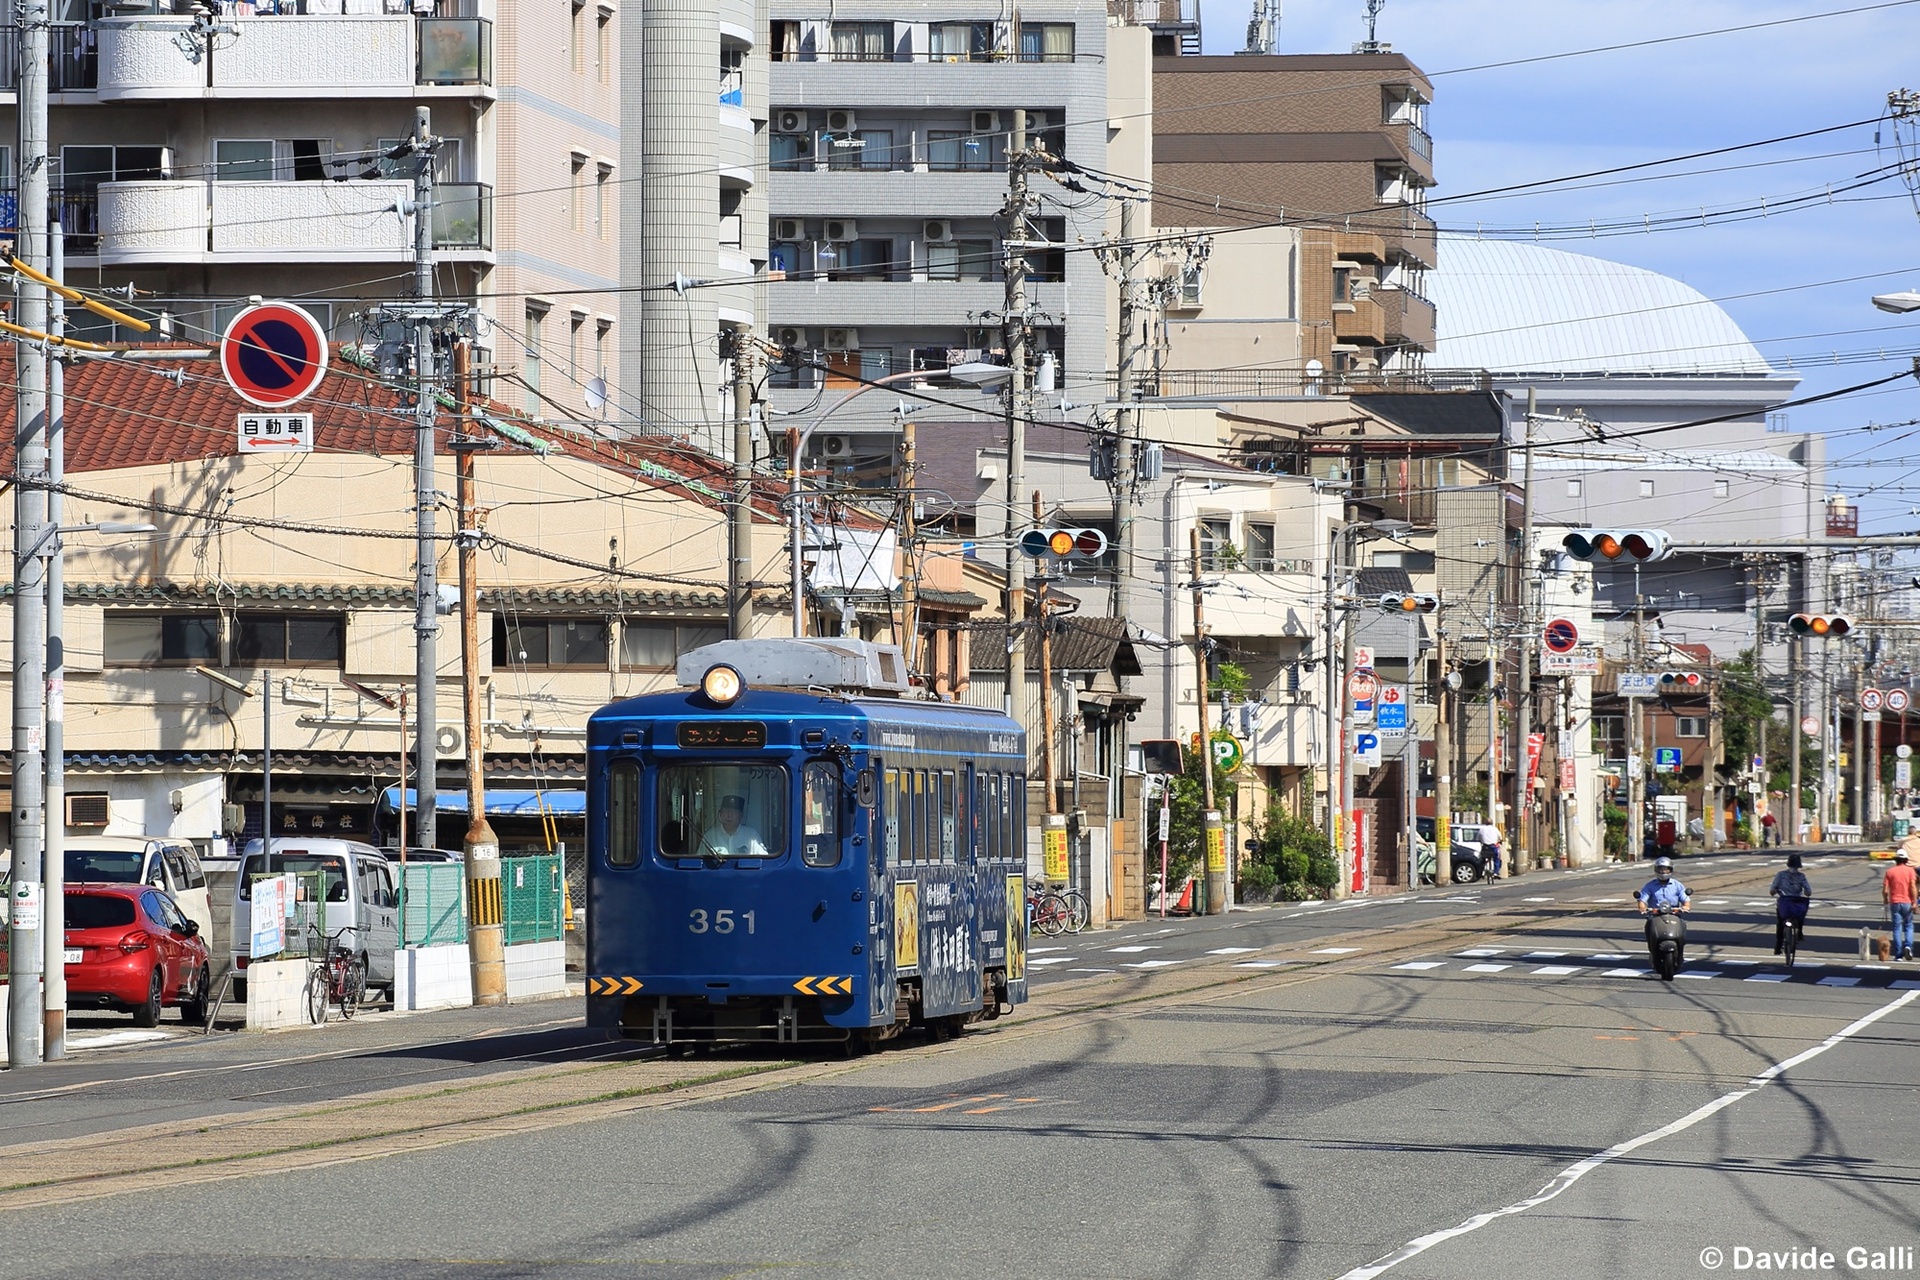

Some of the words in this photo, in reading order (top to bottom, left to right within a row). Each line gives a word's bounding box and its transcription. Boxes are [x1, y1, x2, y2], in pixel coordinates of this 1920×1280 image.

[244, 419, 303, 434] 自動車
[1351, 683, 1375, 693] 消火栓
[1622, 676, 1656, 687] 玉出東
[1384, 688, 1399, 703] ゆ
[1891, 695, 1904, 705] 40
[1380, 706, 1398, 715] 軟水
[1380, 717, 1405, 726] エステ
[1358, 734, 1378, 754] P
[1213, 741, 1234, 765] P
[1662, 749, 1674, 764] P
[751, 769, 778, 780] ワンマン
[284, 815, 353, 829] 熱海荘
[482, 848, 491, 857] 16
[1058, 833, 1067, 873] 駐車禁止
[688, 908, 755, 934] 351
